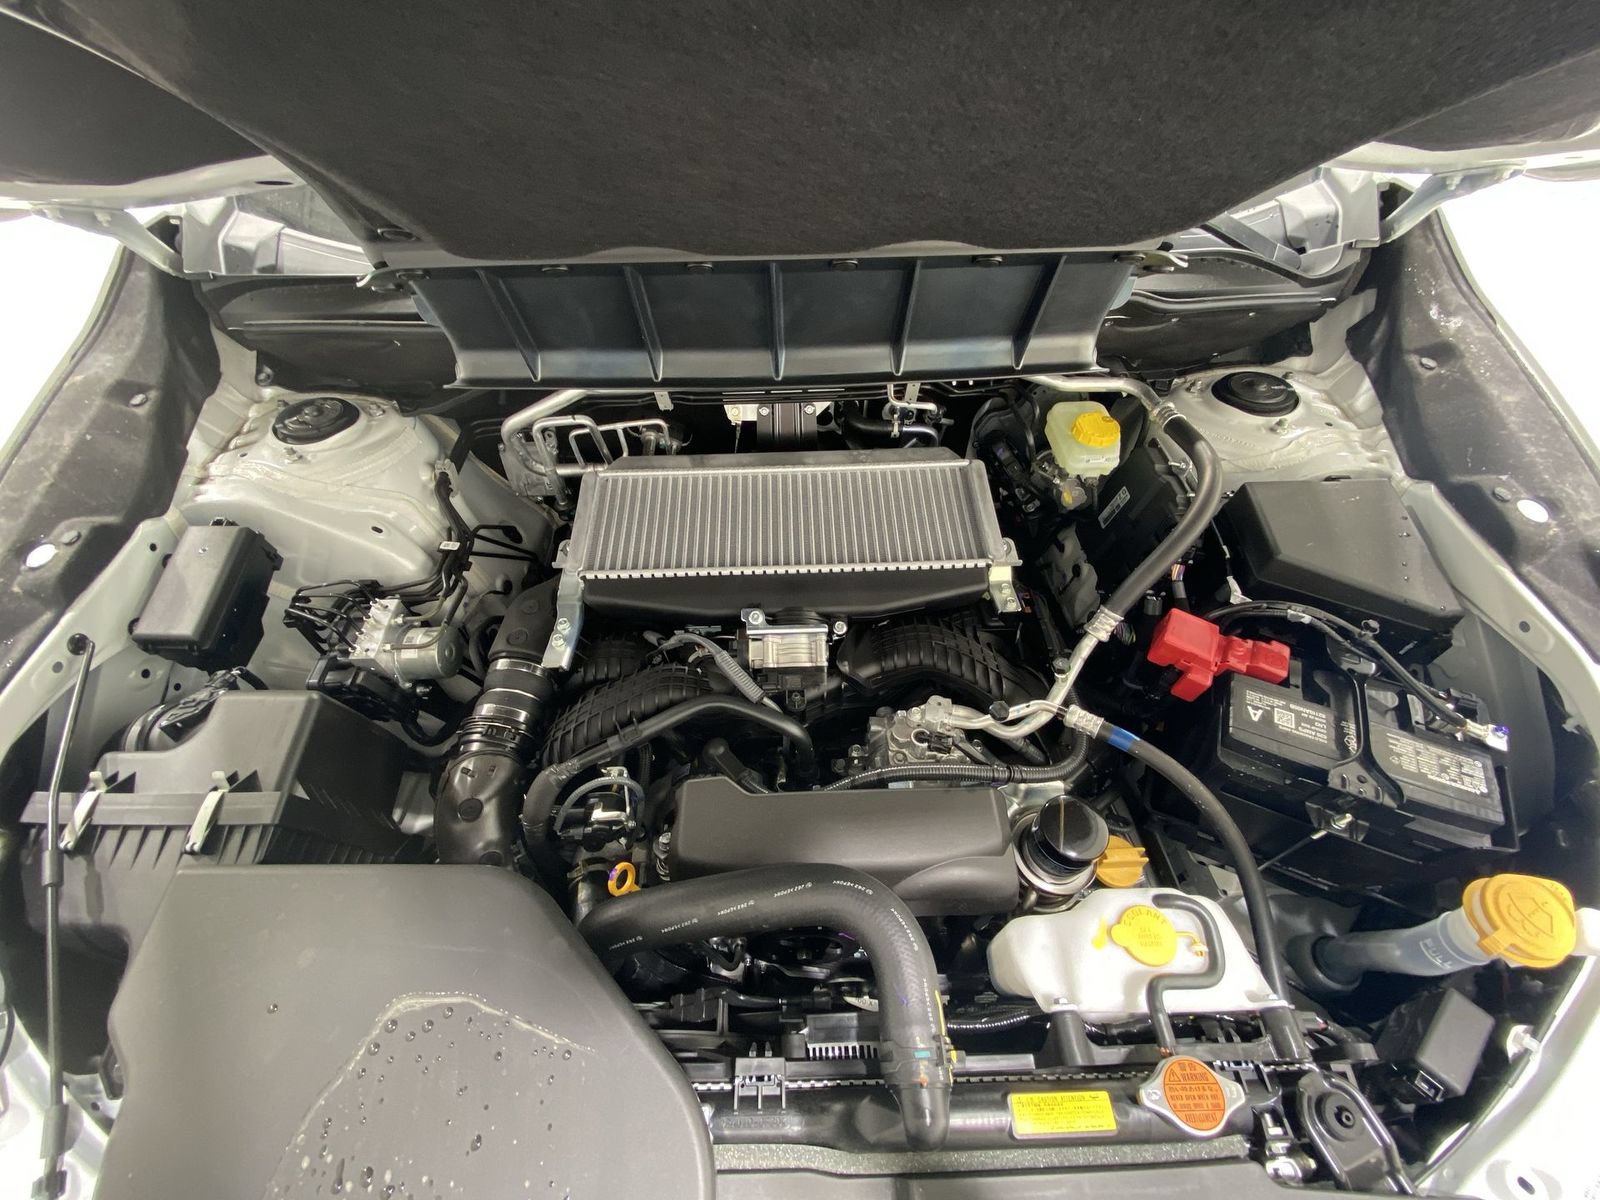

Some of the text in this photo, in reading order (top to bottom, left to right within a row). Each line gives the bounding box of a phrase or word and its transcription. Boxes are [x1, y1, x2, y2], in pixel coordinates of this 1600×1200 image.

[1246, 705, 1263, 721] A
[1123, 907, 1168, 927] COOLANT
[1180, 1071, 1209, 1082] WARNING
